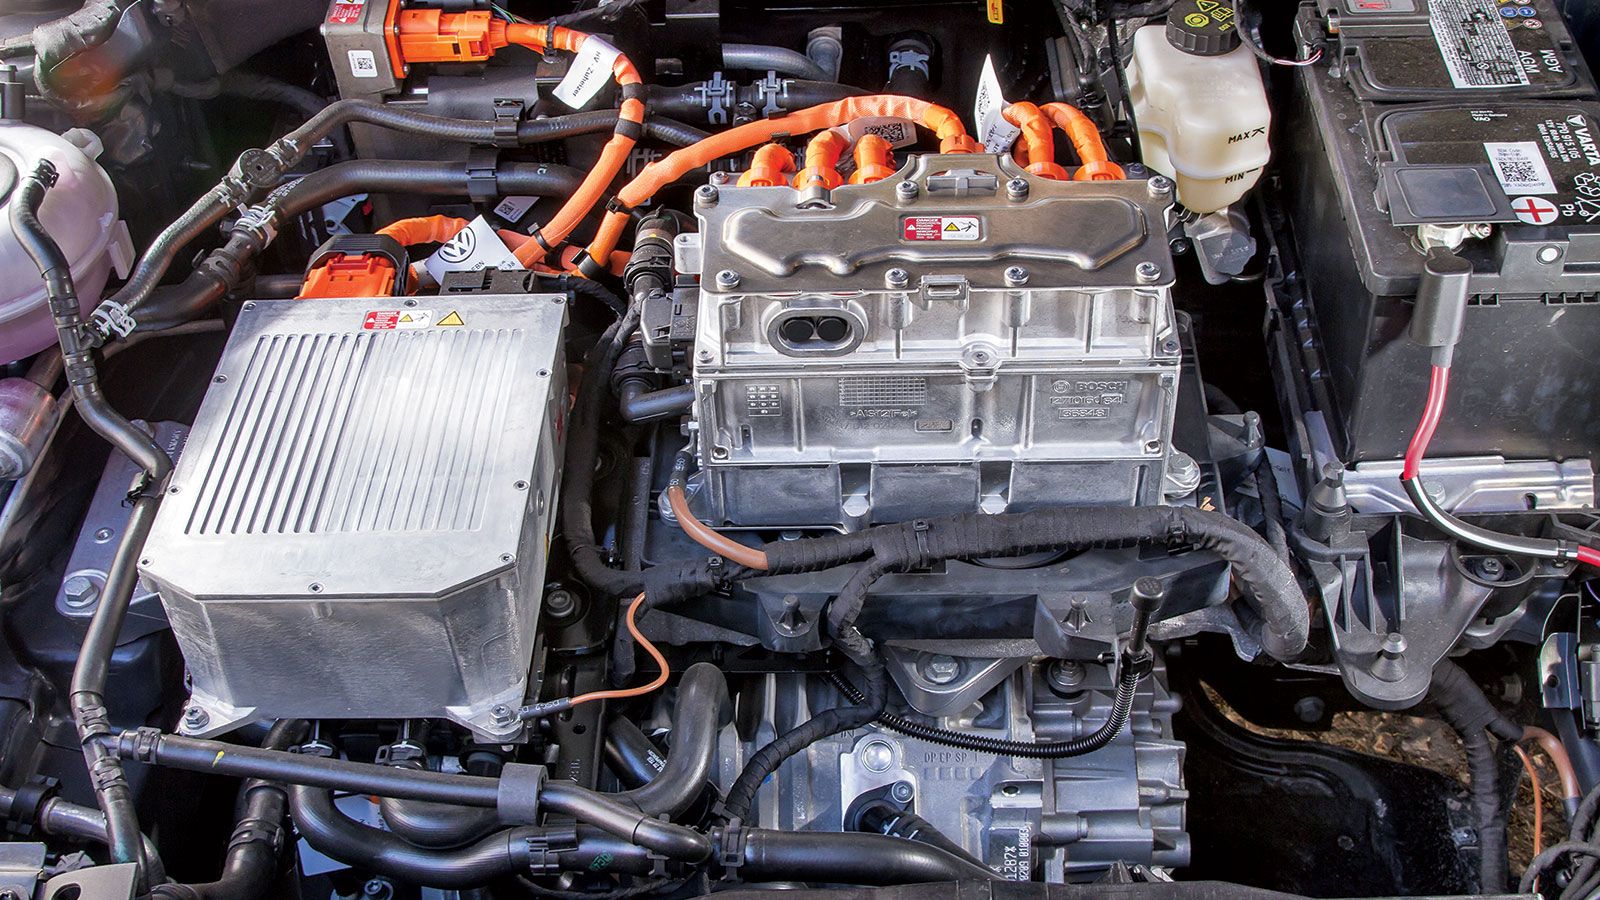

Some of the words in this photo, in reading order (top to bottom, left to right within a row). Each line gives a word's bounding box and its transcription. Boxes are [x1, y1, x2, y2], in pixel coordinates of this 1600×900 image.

[1516, 49, 1540, 74] AGM
[1539, 49, 1563, 73] AGM
[1227, 130, 1251, 144] MAX
[1560, 134, 1574, 147] 915
[1574, 127, 1600, 166] VARTA
[1224, 171, 1245, 184] MIN
[1560, 203, 1575, 217] Pb
[1075, 381, 1128, 392] BOSCH
[955, 752, 968, 763] SP
